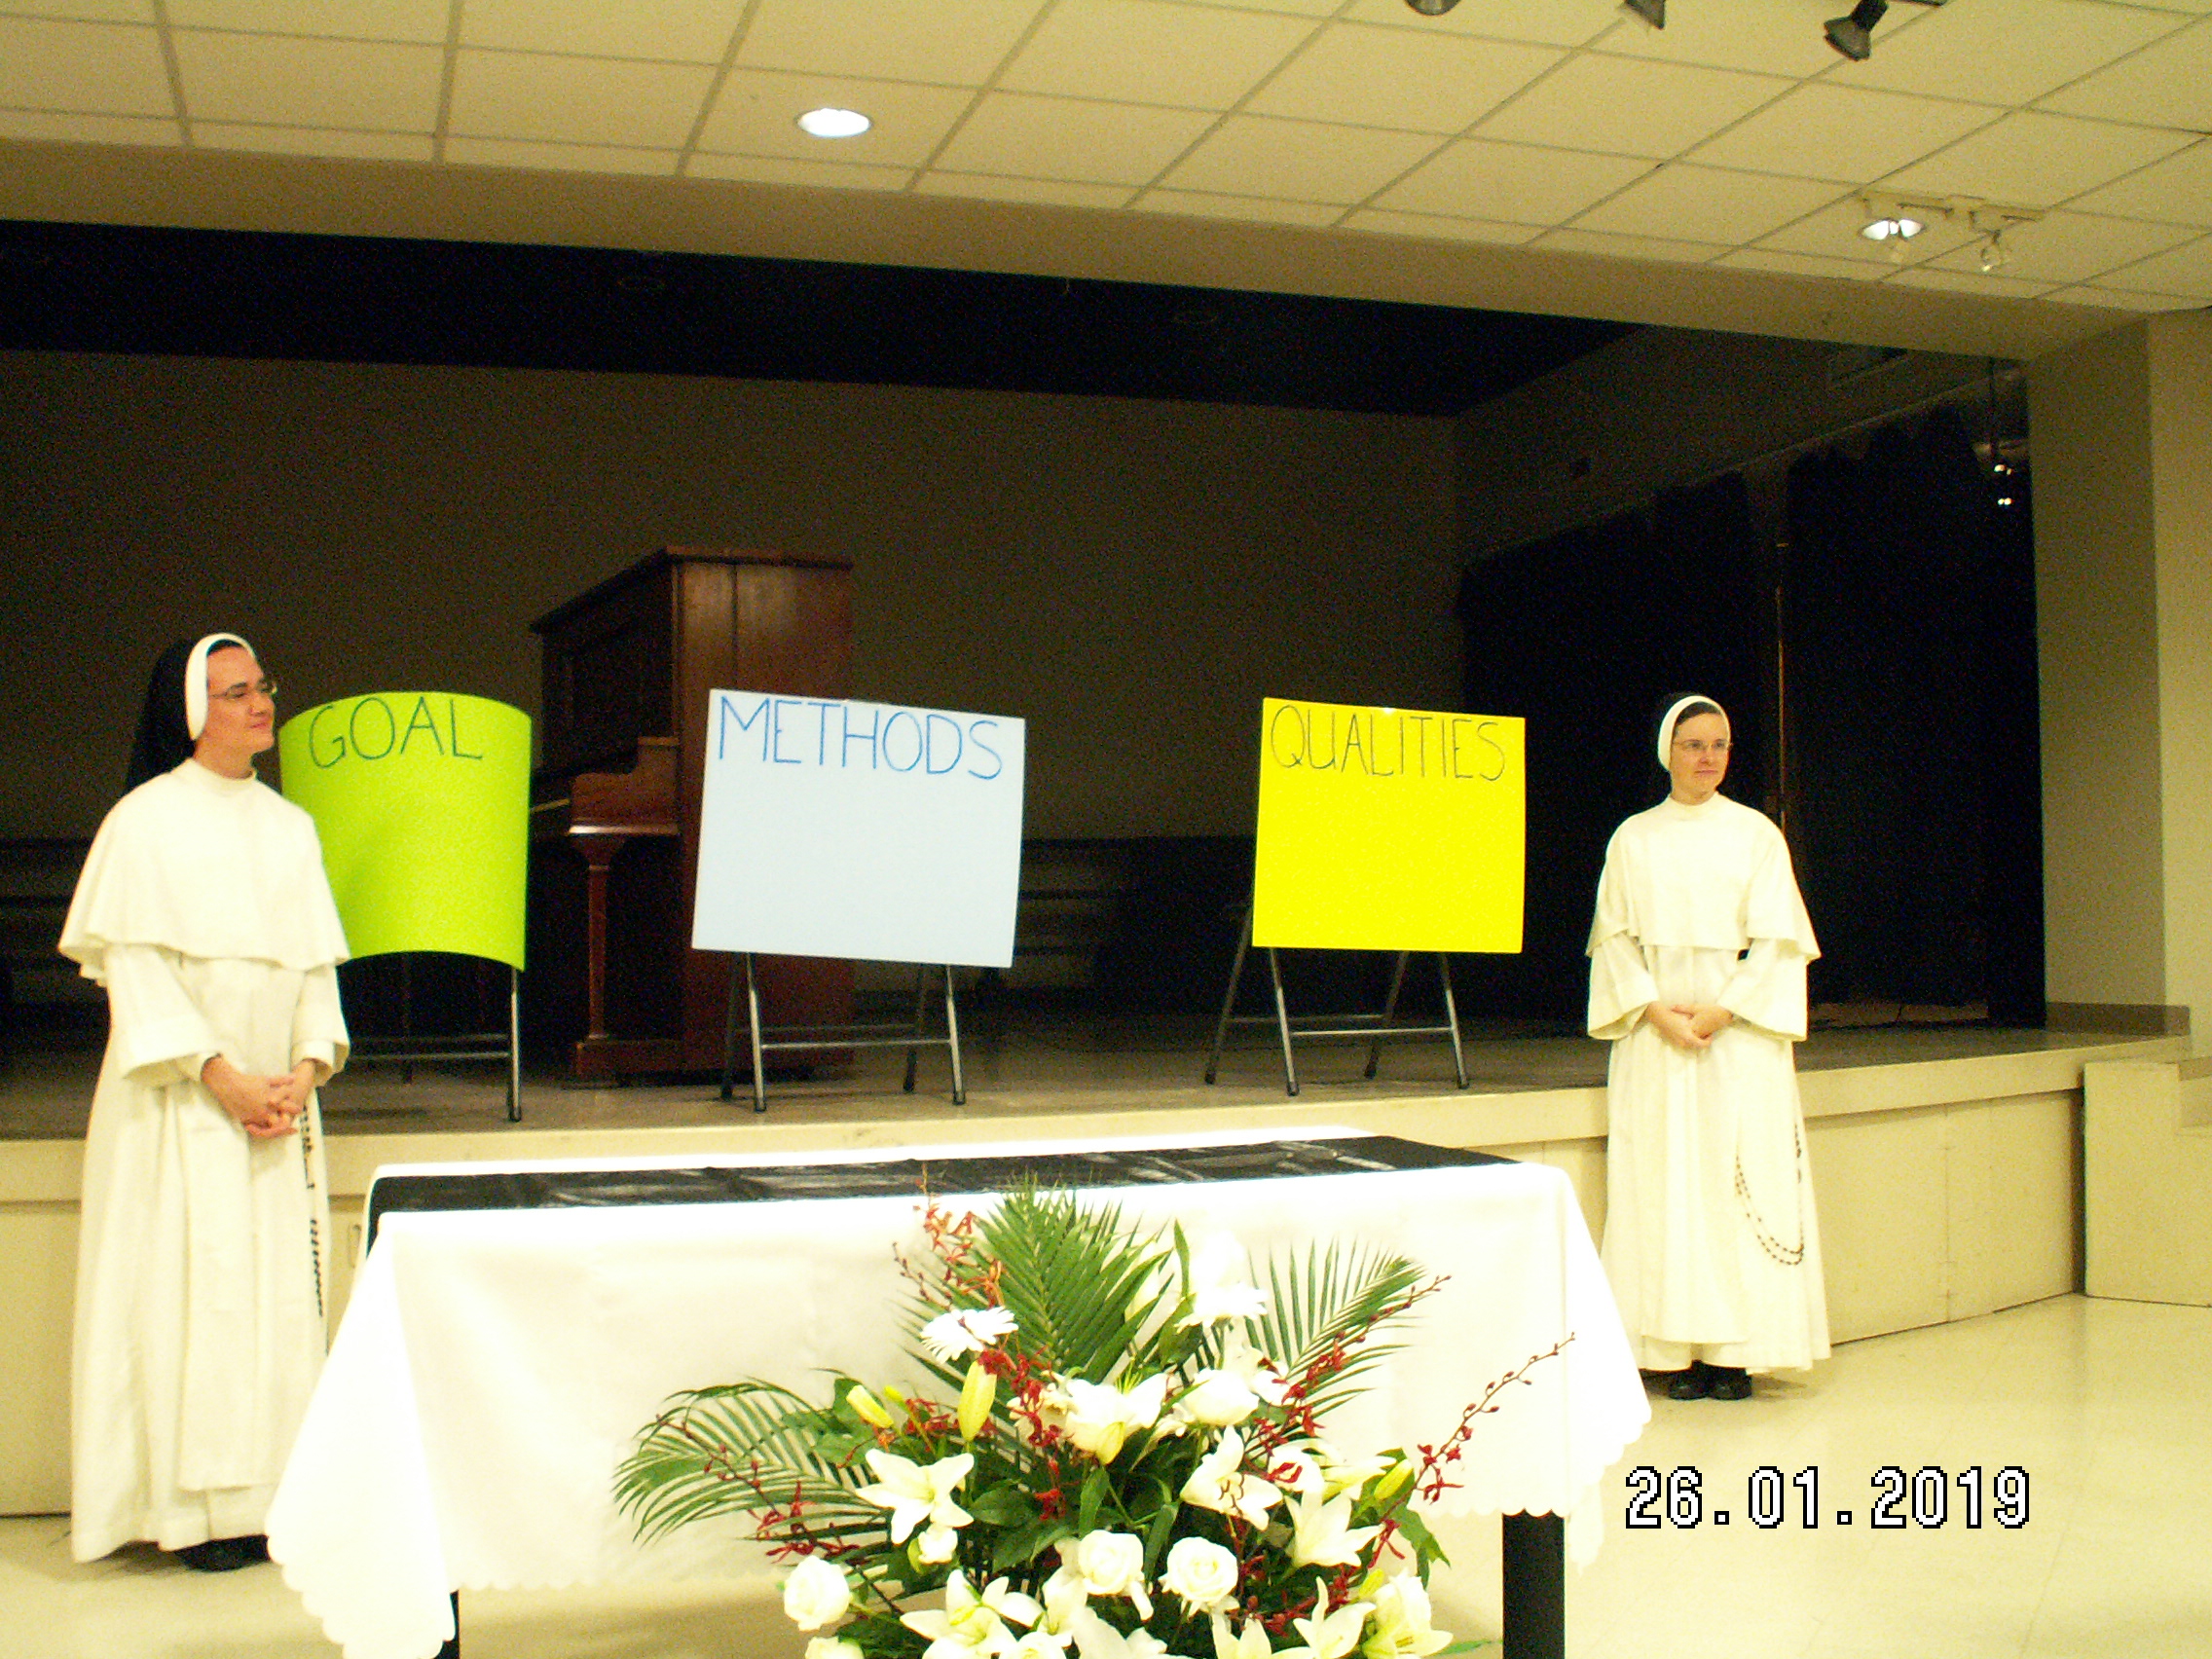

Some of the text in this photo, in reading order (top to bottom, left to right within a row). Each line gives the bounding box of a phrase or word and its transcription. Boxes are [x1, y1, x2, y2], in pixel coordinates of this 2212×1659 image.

[309, 696, 483, 768] GOAL
[719, 695, 1003, 780] METHODS
[1271, 705, 1506, 781] QUALITIES
